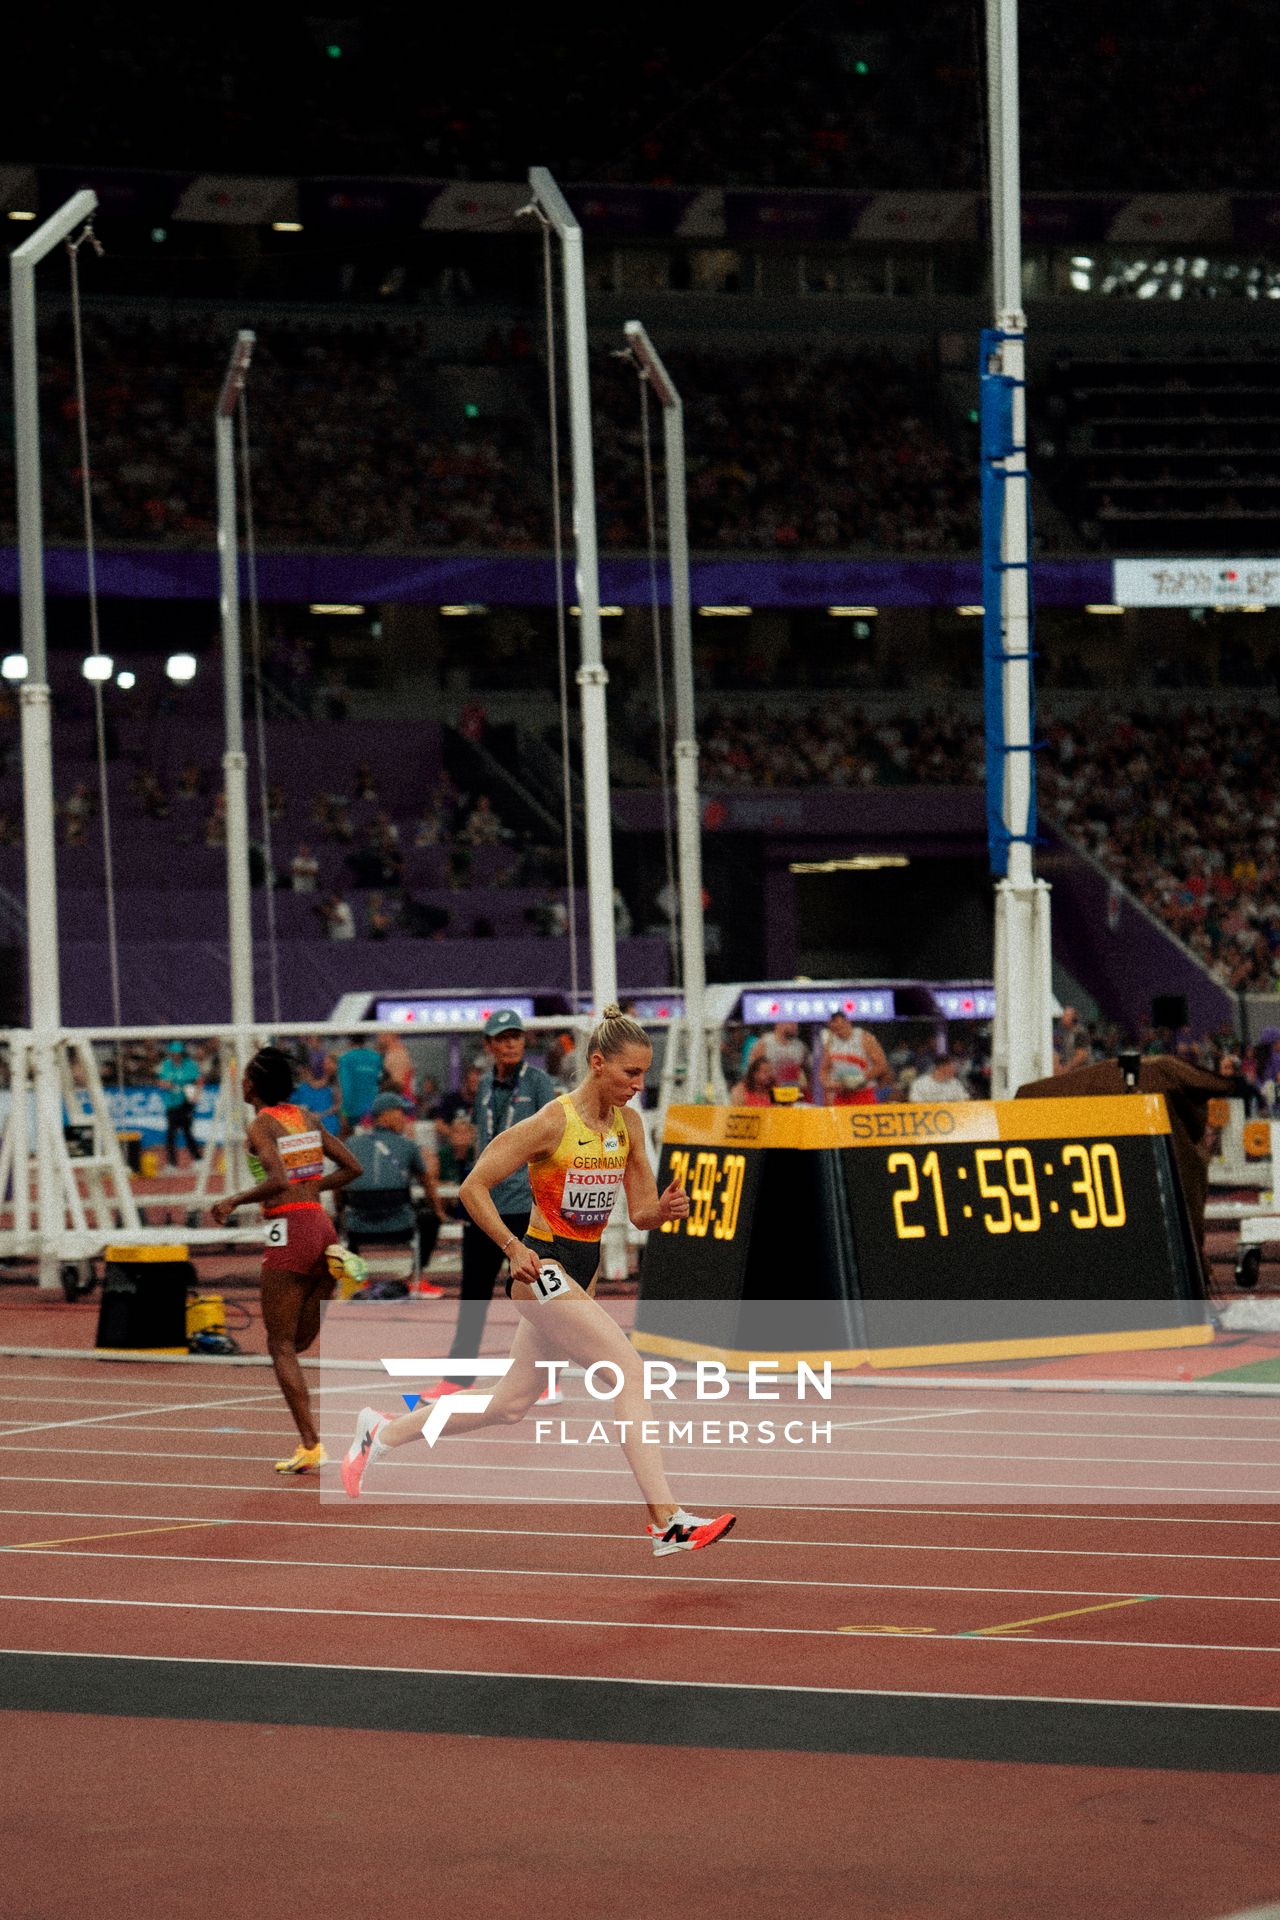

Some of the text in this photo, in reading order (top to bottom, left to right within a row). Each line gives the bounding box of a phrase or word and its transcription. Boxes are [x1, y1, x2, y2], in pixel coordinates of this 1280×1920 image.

[851, 1109, 955, 1138] SEIKO
[573, 1156, 625, 1169] GERMANY
[888, 1143, 1126, 1239] 21:59:30
[270, 1223, 281, 1242] 6
[536, 1269, 562, 1297] 13
